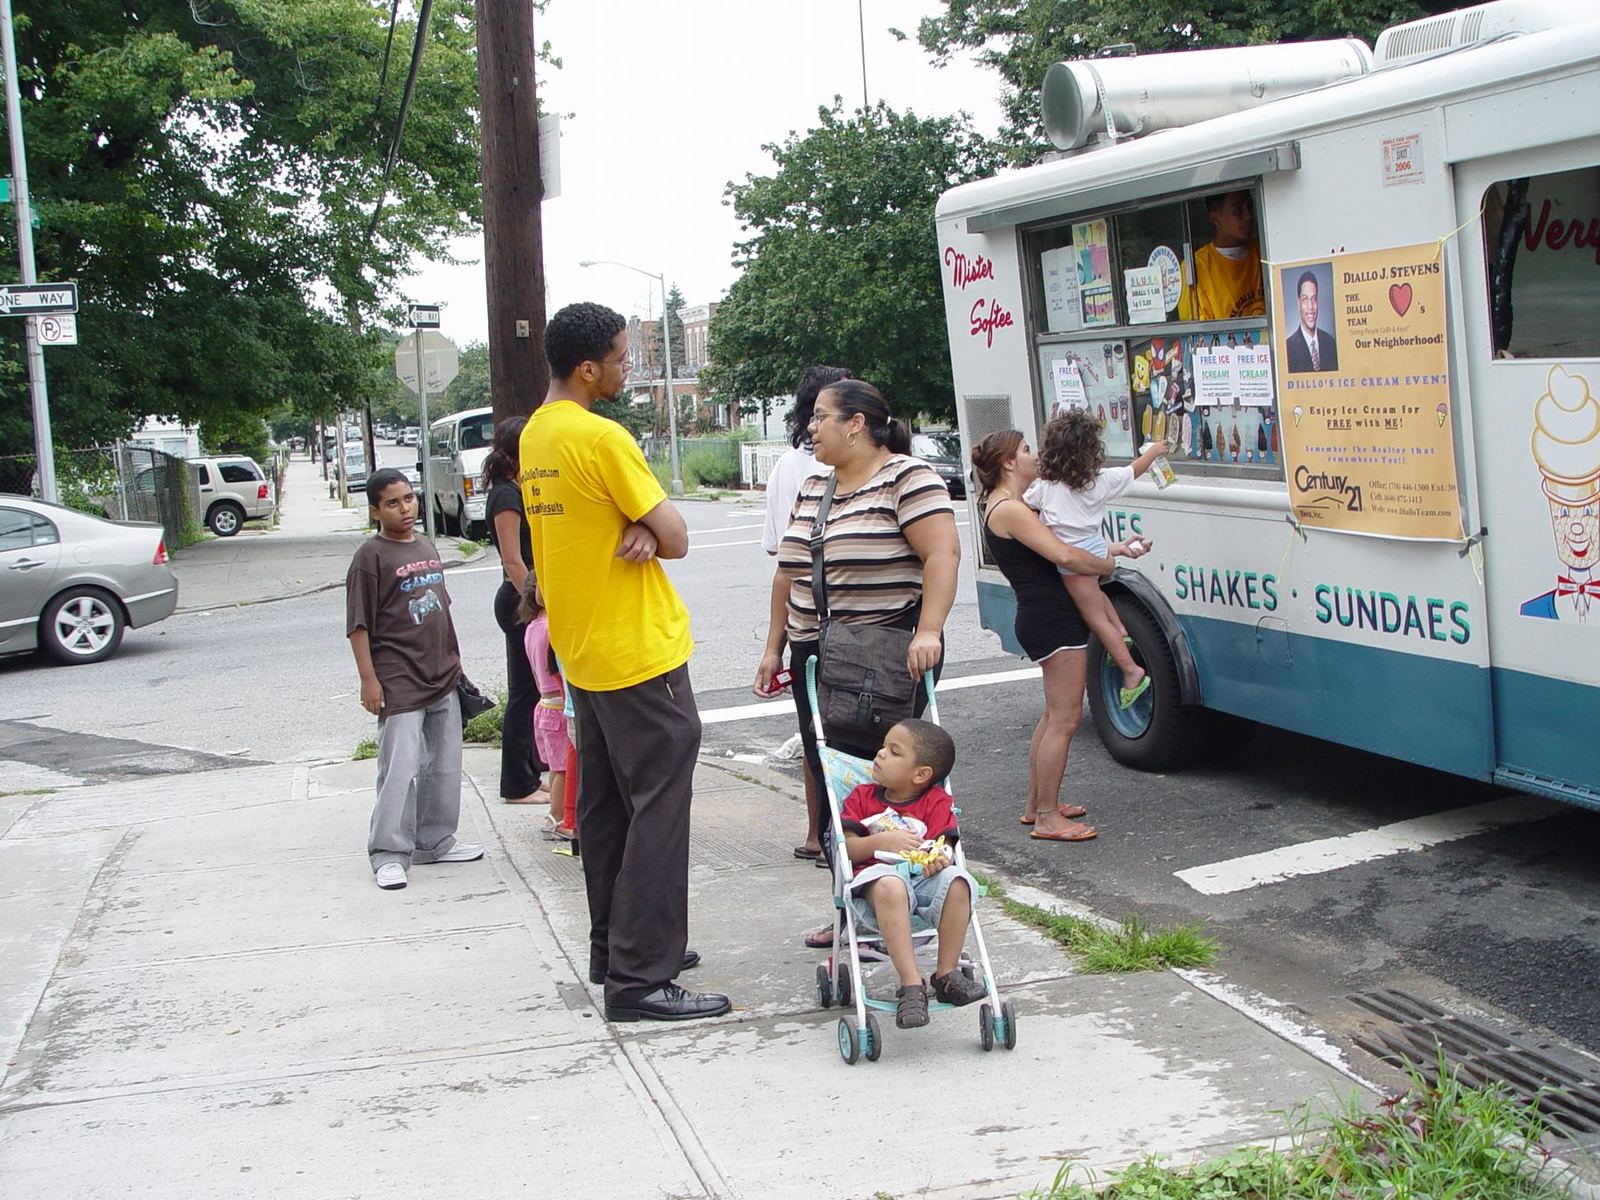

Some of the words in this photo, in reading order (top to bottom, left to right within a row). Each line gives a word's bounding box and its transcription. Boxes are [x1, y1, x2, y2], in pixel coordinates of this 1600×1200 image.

[1395, 161, 1411, 172] 2006
[945, 247, 994, 291] Mister
[1380, 268, 1388, 280] J.
[39, 293, 64, 304] WAY
[1345, 293, 1360, 302] THE
[1346, 304, 1373, 315] DIALLO
[413, 312, 423, 321] ONE
[1347, 317, 1367, 327] TEAM
[970, 298, 1013, 348] Softee
[1355, 339, 1371, 349] Our
[1373, 334, 1444, 349] Neighborhood!
[1200, 356, 1217, 364] FREE
[1218, 355, 1230, 364] ICE
[1238, 355, 1255, 364] FREE
[1257, 354, 1268, 363] ICE
[1059, 367, 1072, 375] FREE
[1287, 379, 1334, 390] DIALLO'S
[1338, 378, 1356, 388] ICE
[1361, 377, 1400, 387] CREAM
[1405, 375, 1447, 386] EVENT
[1309, 406, 1338, 416] Enjoy
[1342, 406, 1358, 414] Ice
[1363, 405, 1396, 414] Cream
[1402, 404, 1420, 414] for
[1326, 418, 1352, 429] FREE
[1355, 418, 1380, 428] with
[1384, 418, 1404, 428] ME!
[1411, 446, 1435, 455] that
[1294, 465, 1348, 494] Century
[1368, 480, 1388, 490] Office:
[1345, 486, 1363, 512] 21
[396, 560, 428, 577] GAME
[1174, 564, 1278, 612] SHAKES
[1315, 584, 1471, 645] SUNDAES
